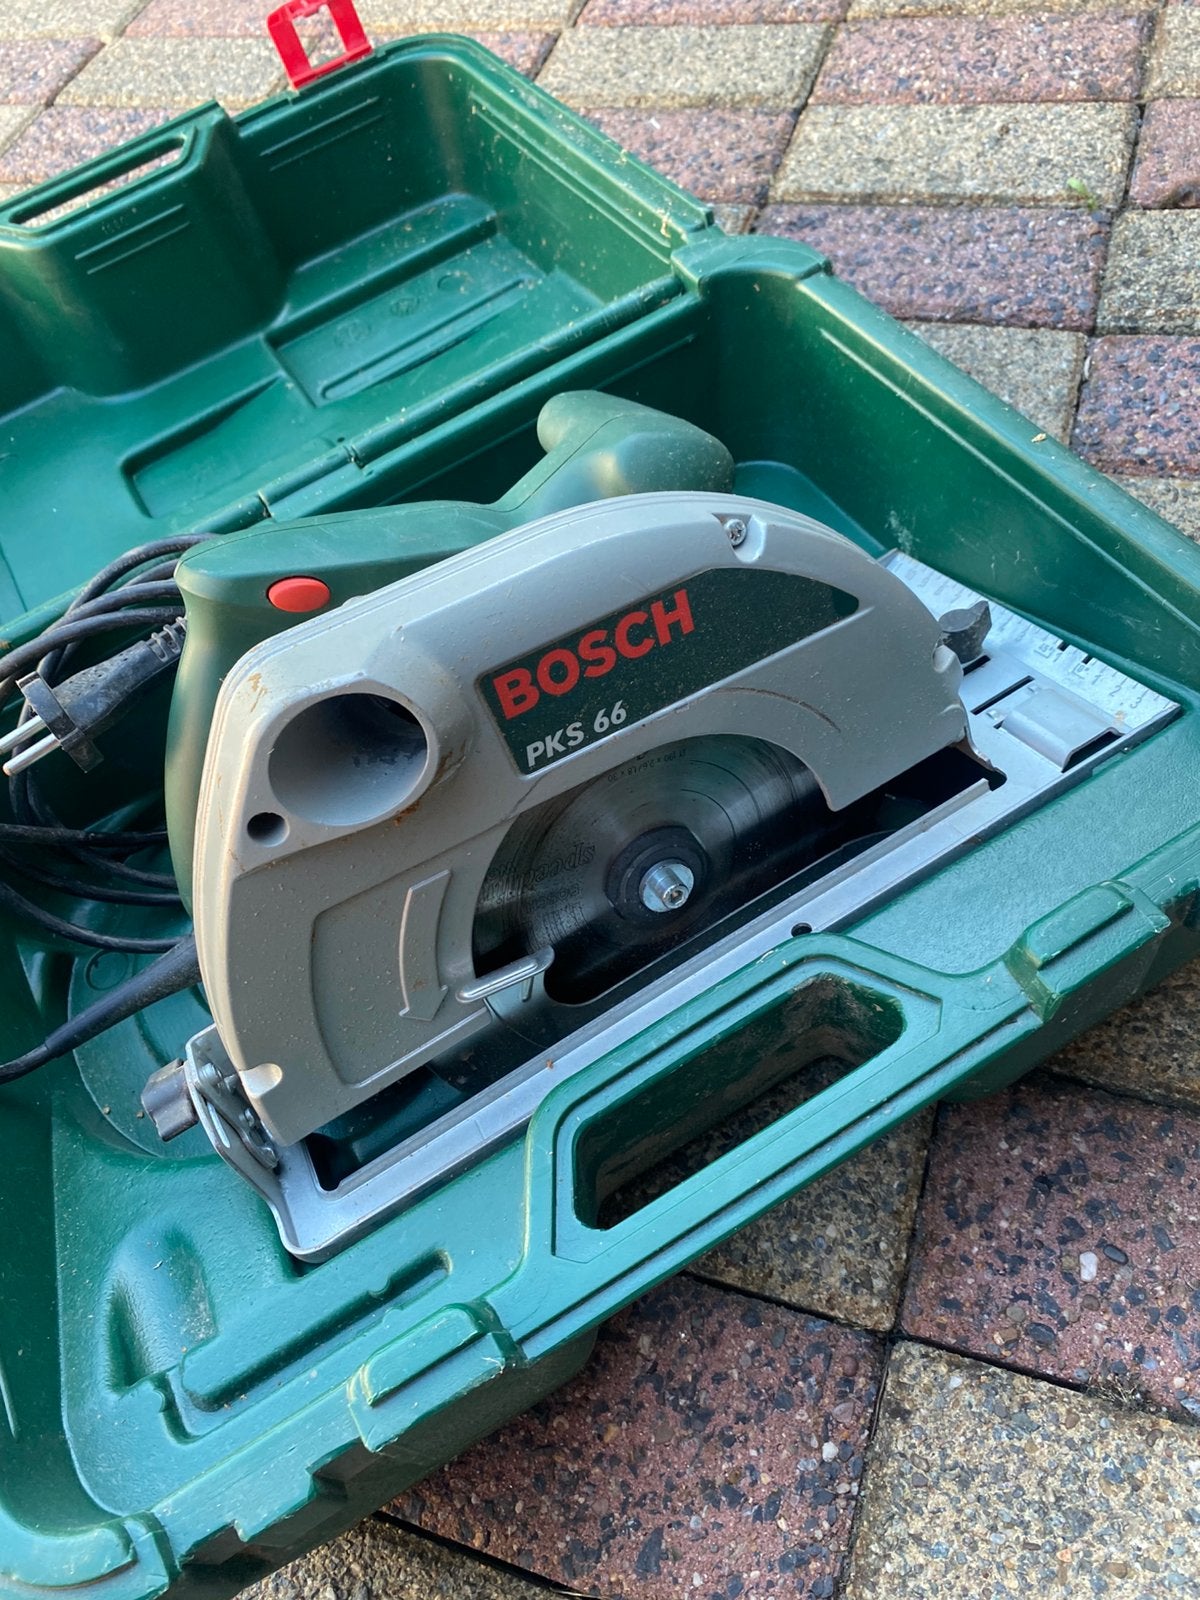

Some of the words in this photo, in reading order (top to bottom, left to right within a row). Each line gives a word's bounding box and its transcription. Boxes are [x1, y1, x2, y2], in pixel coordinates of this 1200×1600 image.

[493, 589, 695, 719] BOSCH
[1109, 684, 1122, 697] 2
[1129, 696, 1143, 709] 3
[526, 721, 585, 767] PKS
[593, 701, 628, 734] 66
